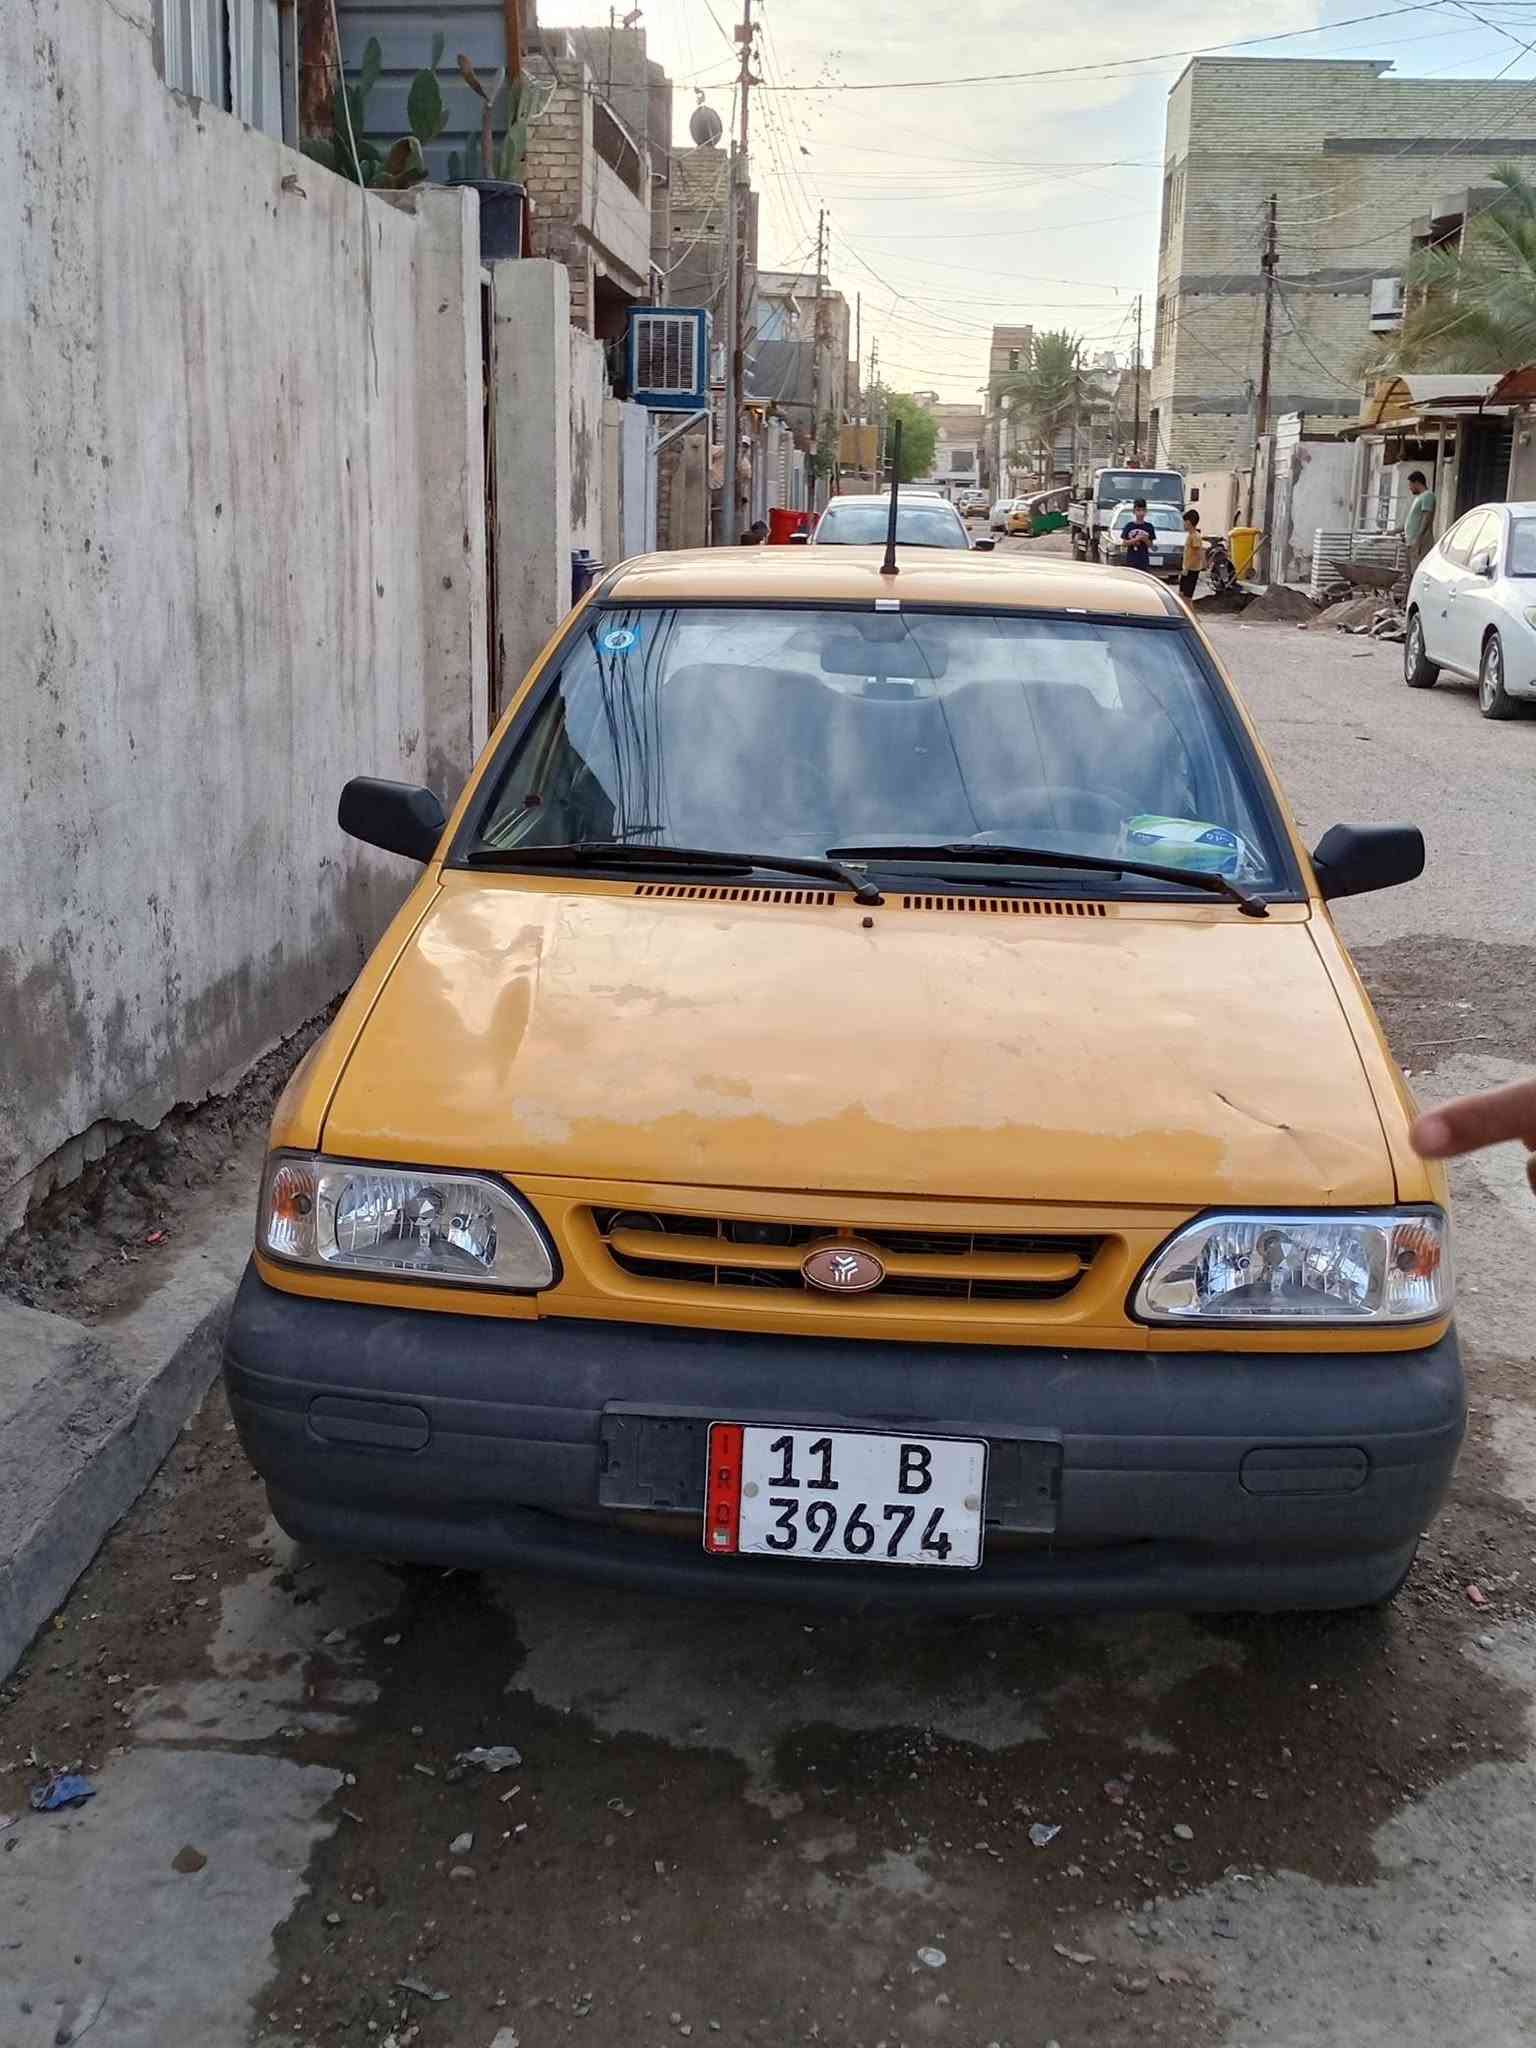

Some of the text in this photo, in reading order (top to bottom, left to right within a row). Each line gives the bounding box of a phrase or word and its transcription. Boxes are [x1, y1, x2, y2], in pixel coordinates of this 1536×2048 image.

[768, 1435, 839, 1490] 11
[897, 1443, 933, 1495] B
[765, 1497, 953, 1560] 39674
